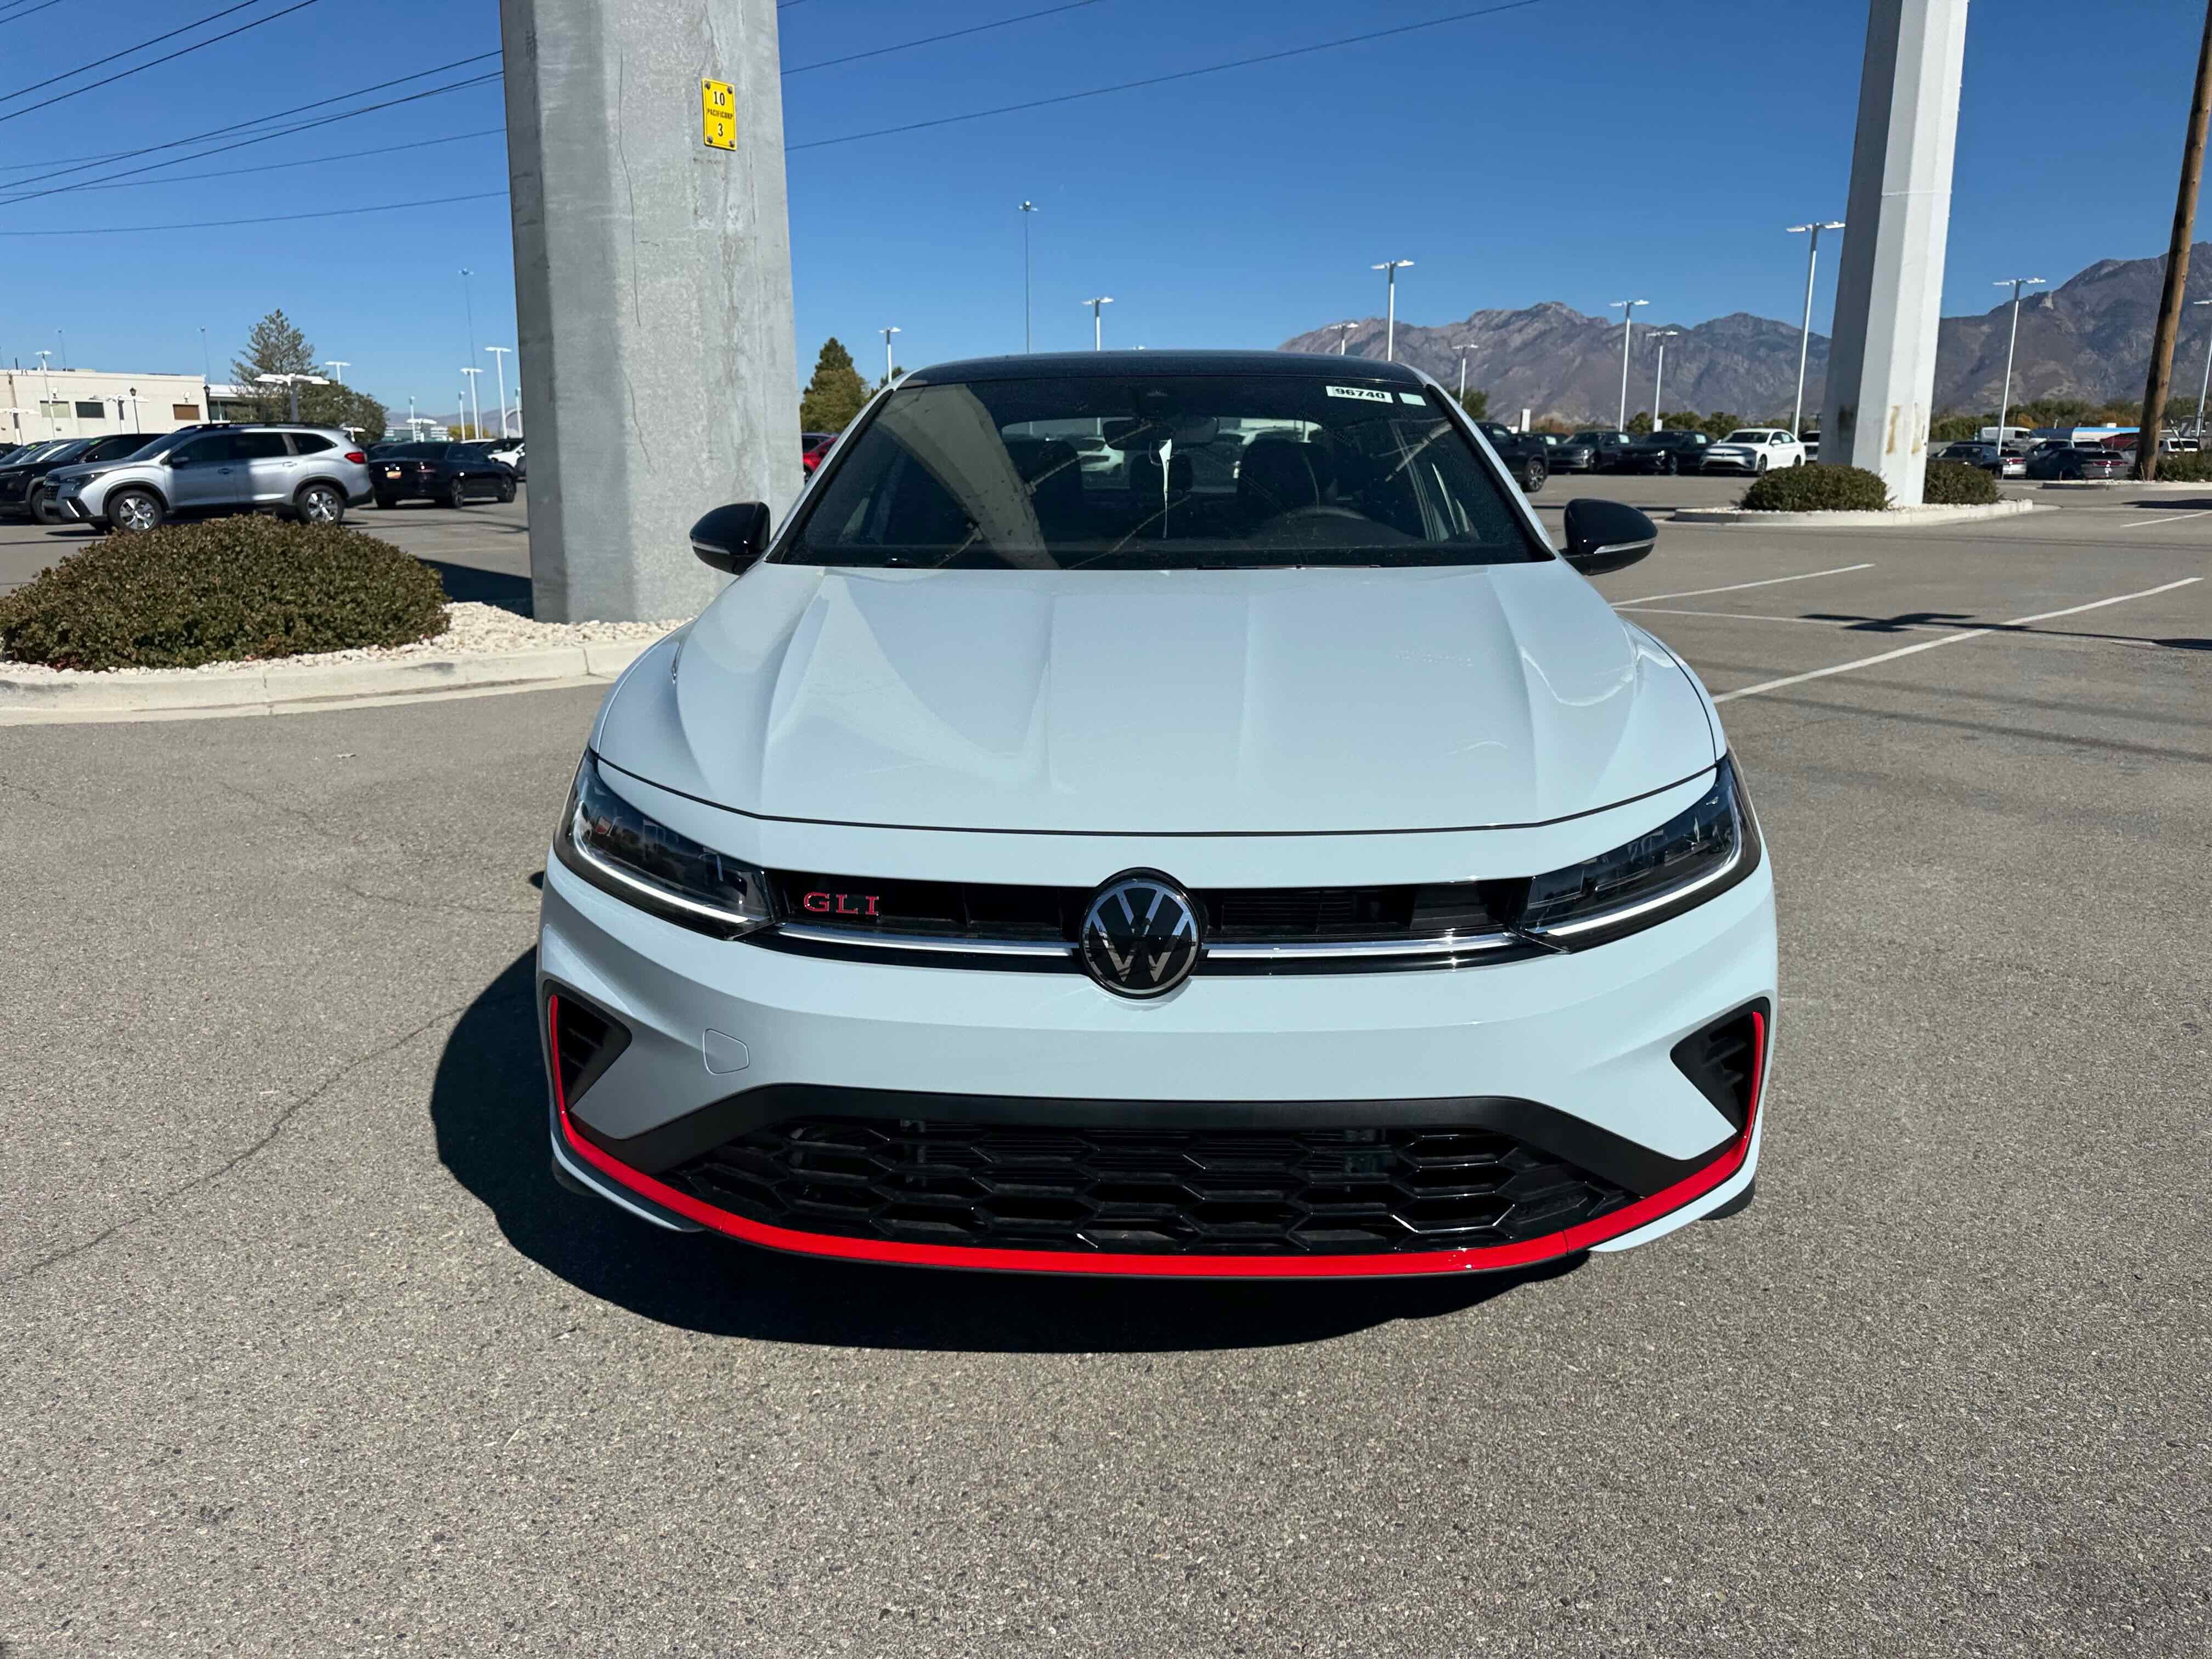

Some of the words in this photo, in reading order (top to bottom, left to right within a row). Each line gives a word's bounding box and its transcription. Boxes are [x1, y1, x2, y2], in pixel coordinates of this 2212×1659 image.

[714, 91, 725, 106] 10
[718, 123, 724, 137] 3
[1335, 388, 1385, 399] 96740
[804, 891, 879, 916] GLI
